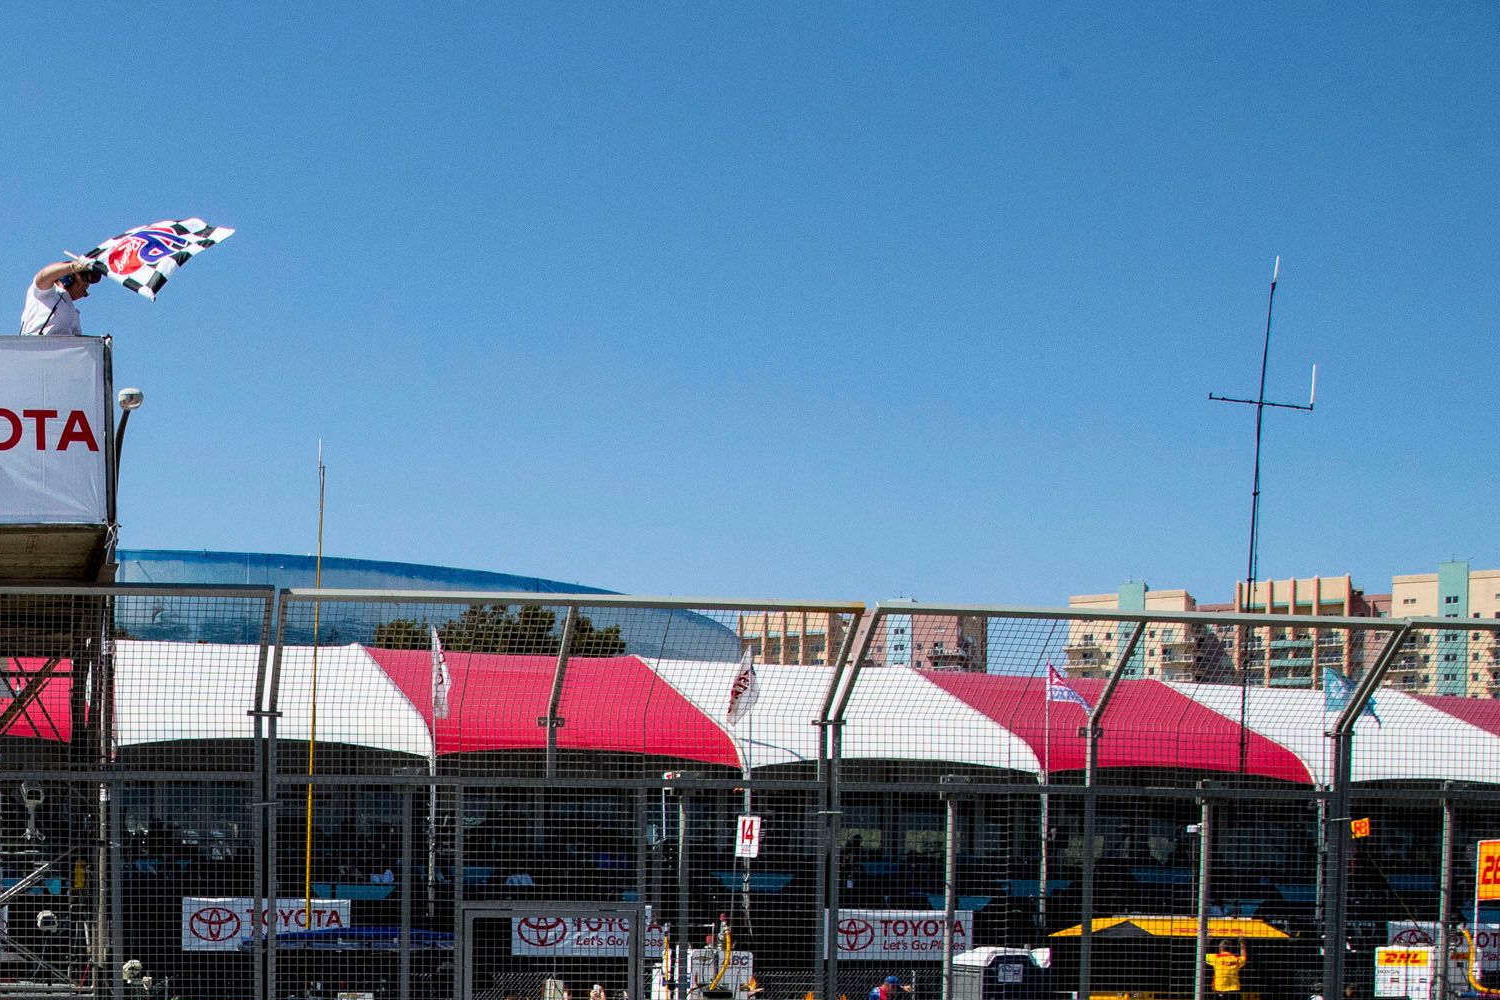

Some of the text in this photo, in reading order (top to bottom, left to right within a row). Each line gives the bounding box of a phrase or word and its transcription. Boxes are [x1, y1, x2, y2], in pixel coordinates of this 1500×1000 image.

[741, 819, 754, 844] 14
[576, 935, 603, 946] Let's
[607, 935, 623, 946] Go
[883, 940, 908, 950] Let's
[911, 940, 928, 950] Go
[1385, 953, 1421, 963] DHL
